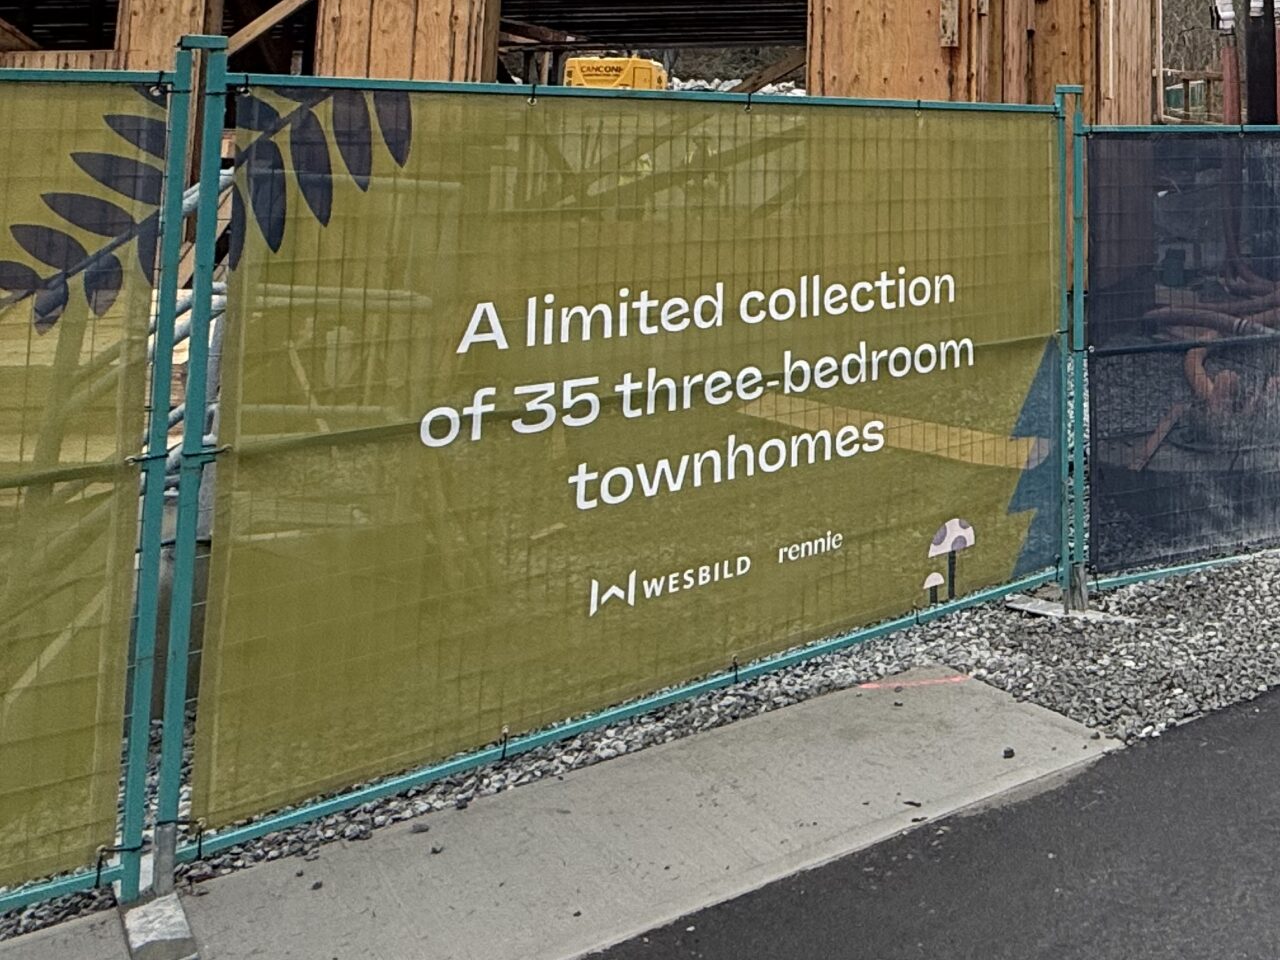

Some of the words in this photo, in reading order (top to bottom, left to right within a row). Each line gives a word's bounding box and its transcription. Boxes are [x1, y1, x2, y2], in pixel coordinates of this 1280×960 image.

[456, 302, 509, 354] A
[526, 282, 724, 347] limited
[739, 267, 956, 324] collection
[420, 388, 496, 448] of
[511, 377, 600, 434] 35
[615, 337, 975, 418] three-bedroom
[568, 420, 885, 510] townhomes
[642, 555, 751, 599] WESBILD
[778, 531, 843, 563] rennie
